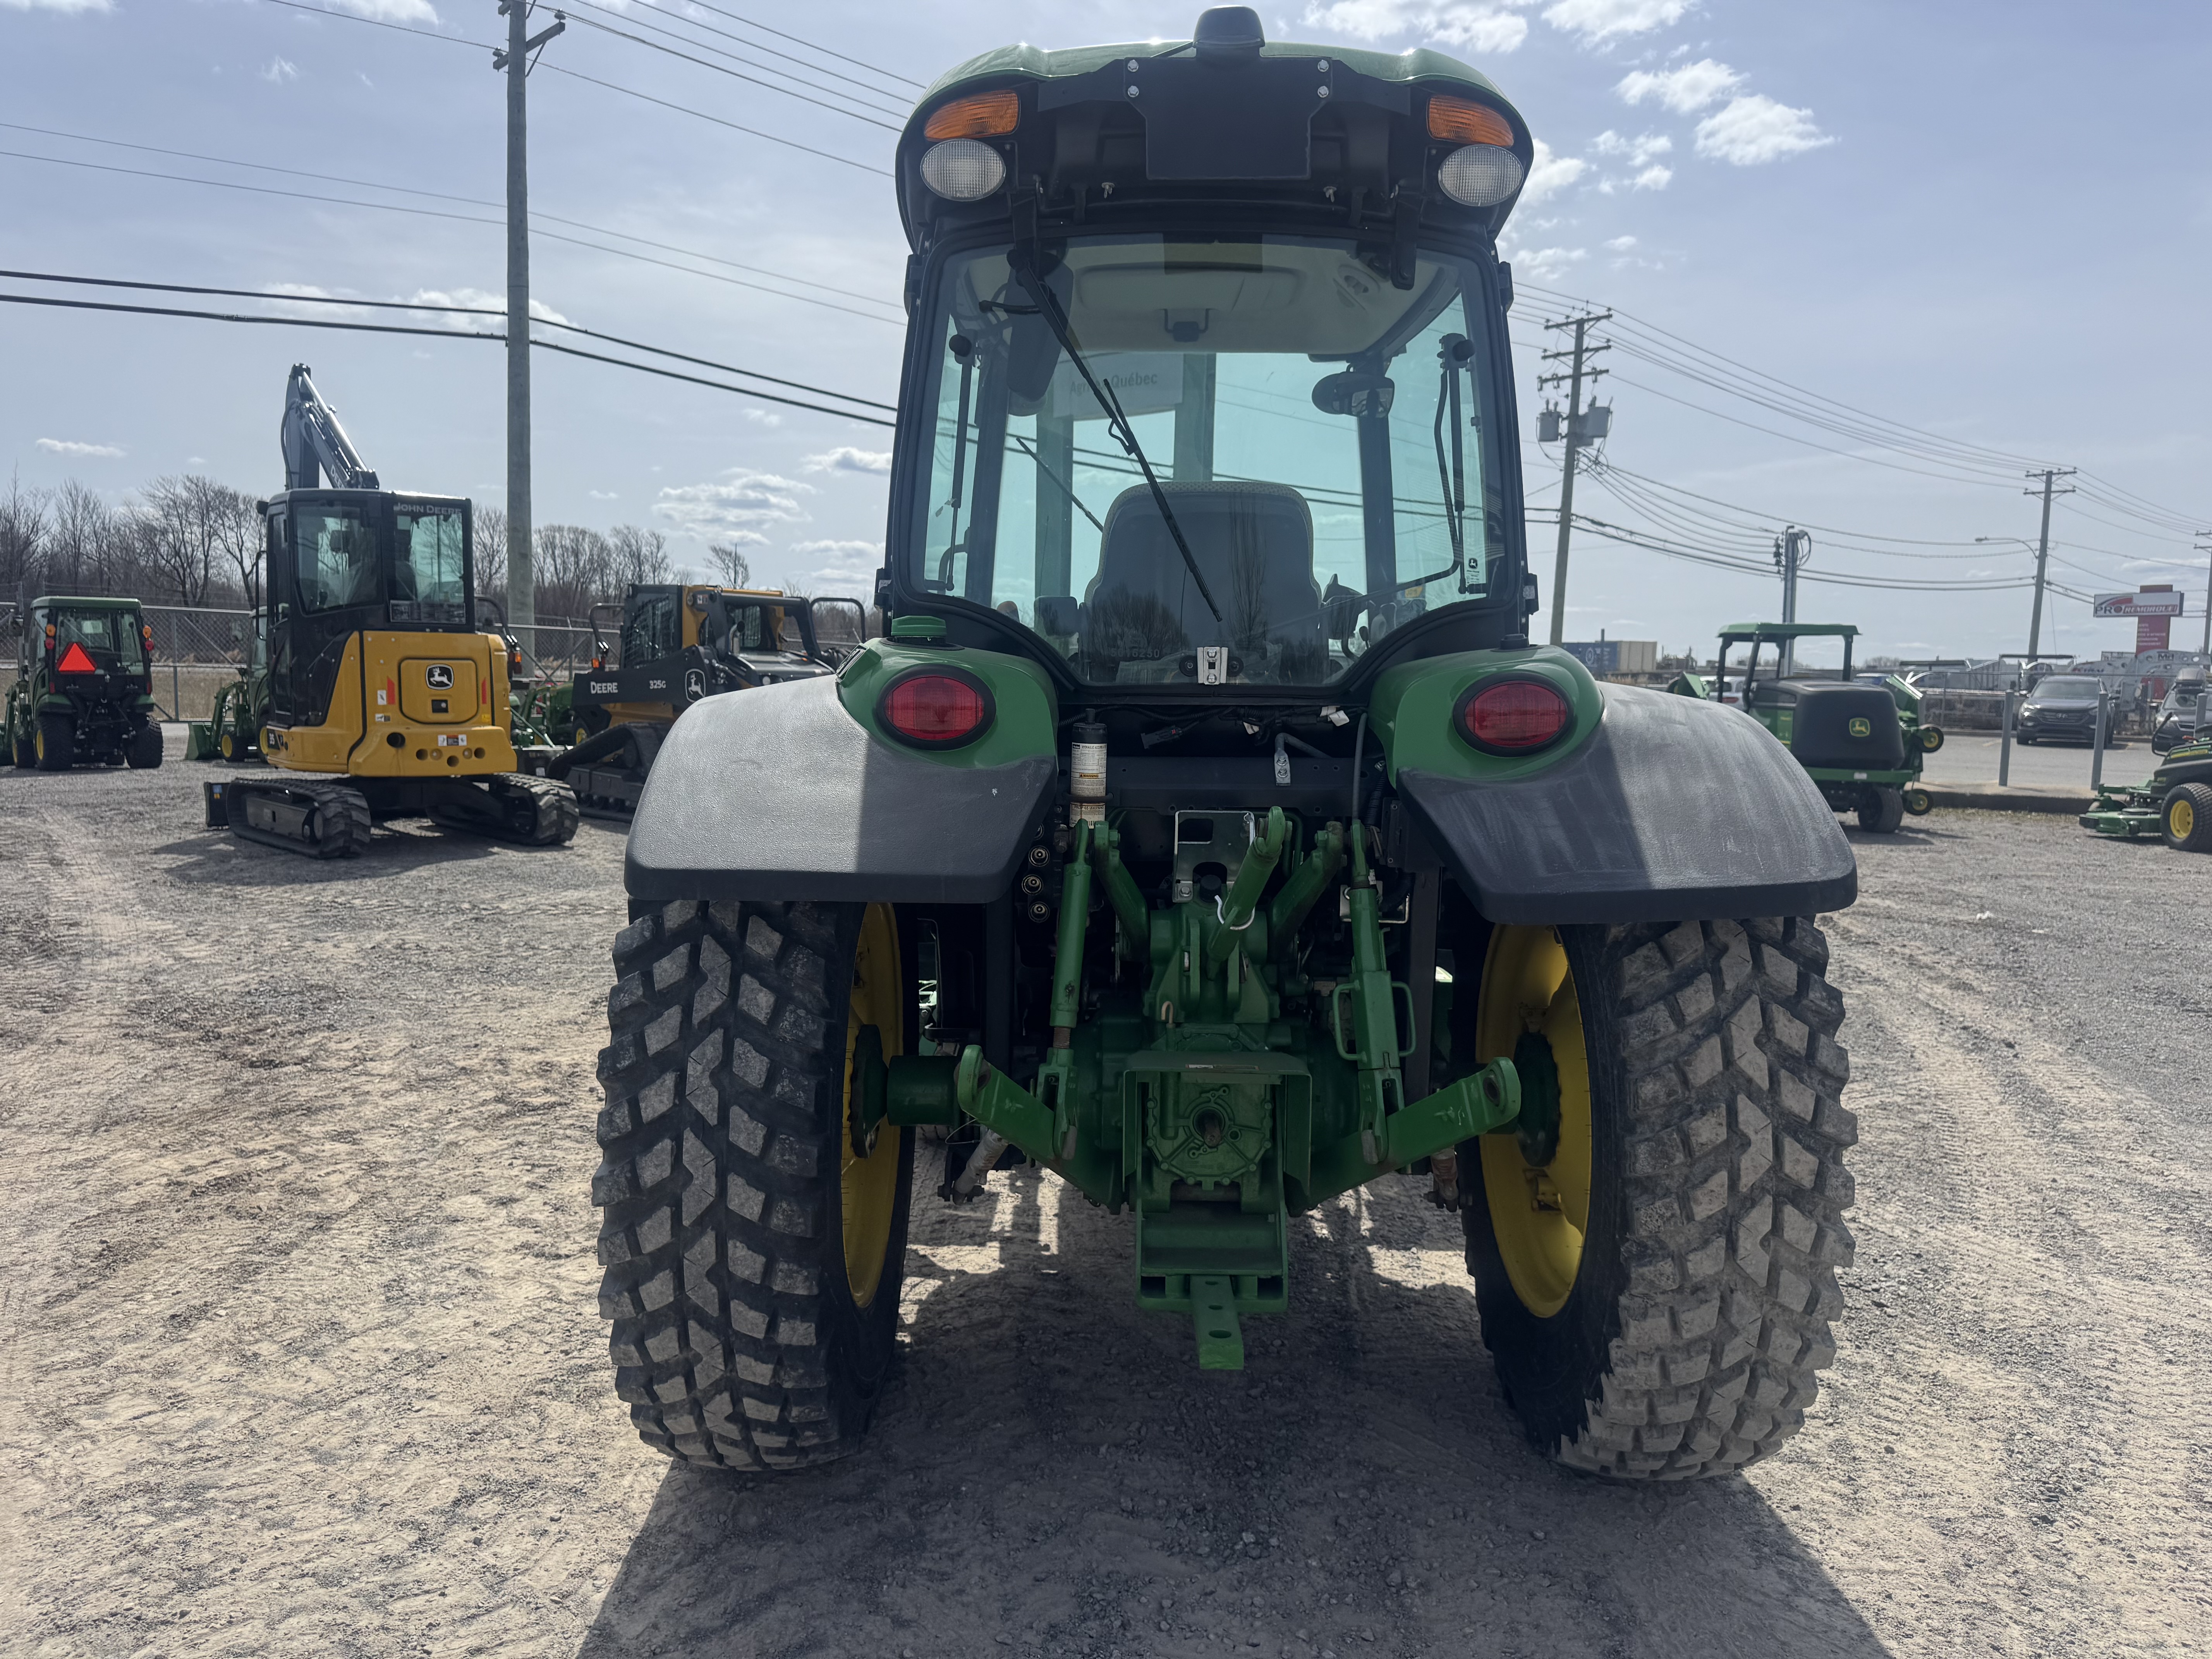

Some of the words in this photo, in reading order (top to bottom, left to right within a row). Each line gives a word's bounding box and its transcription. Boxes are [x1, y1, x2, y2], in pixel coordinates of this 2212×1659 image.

[1111, 372, 1158, 388] Québec
[393, 502, 424, 513] JOHN
[427, 505, 462, 515] DEERE
[2095, 606, 2122, 614] PRO
[591, 681, 618, 694] DEERE
[649, 680, 666, 689] 325G
